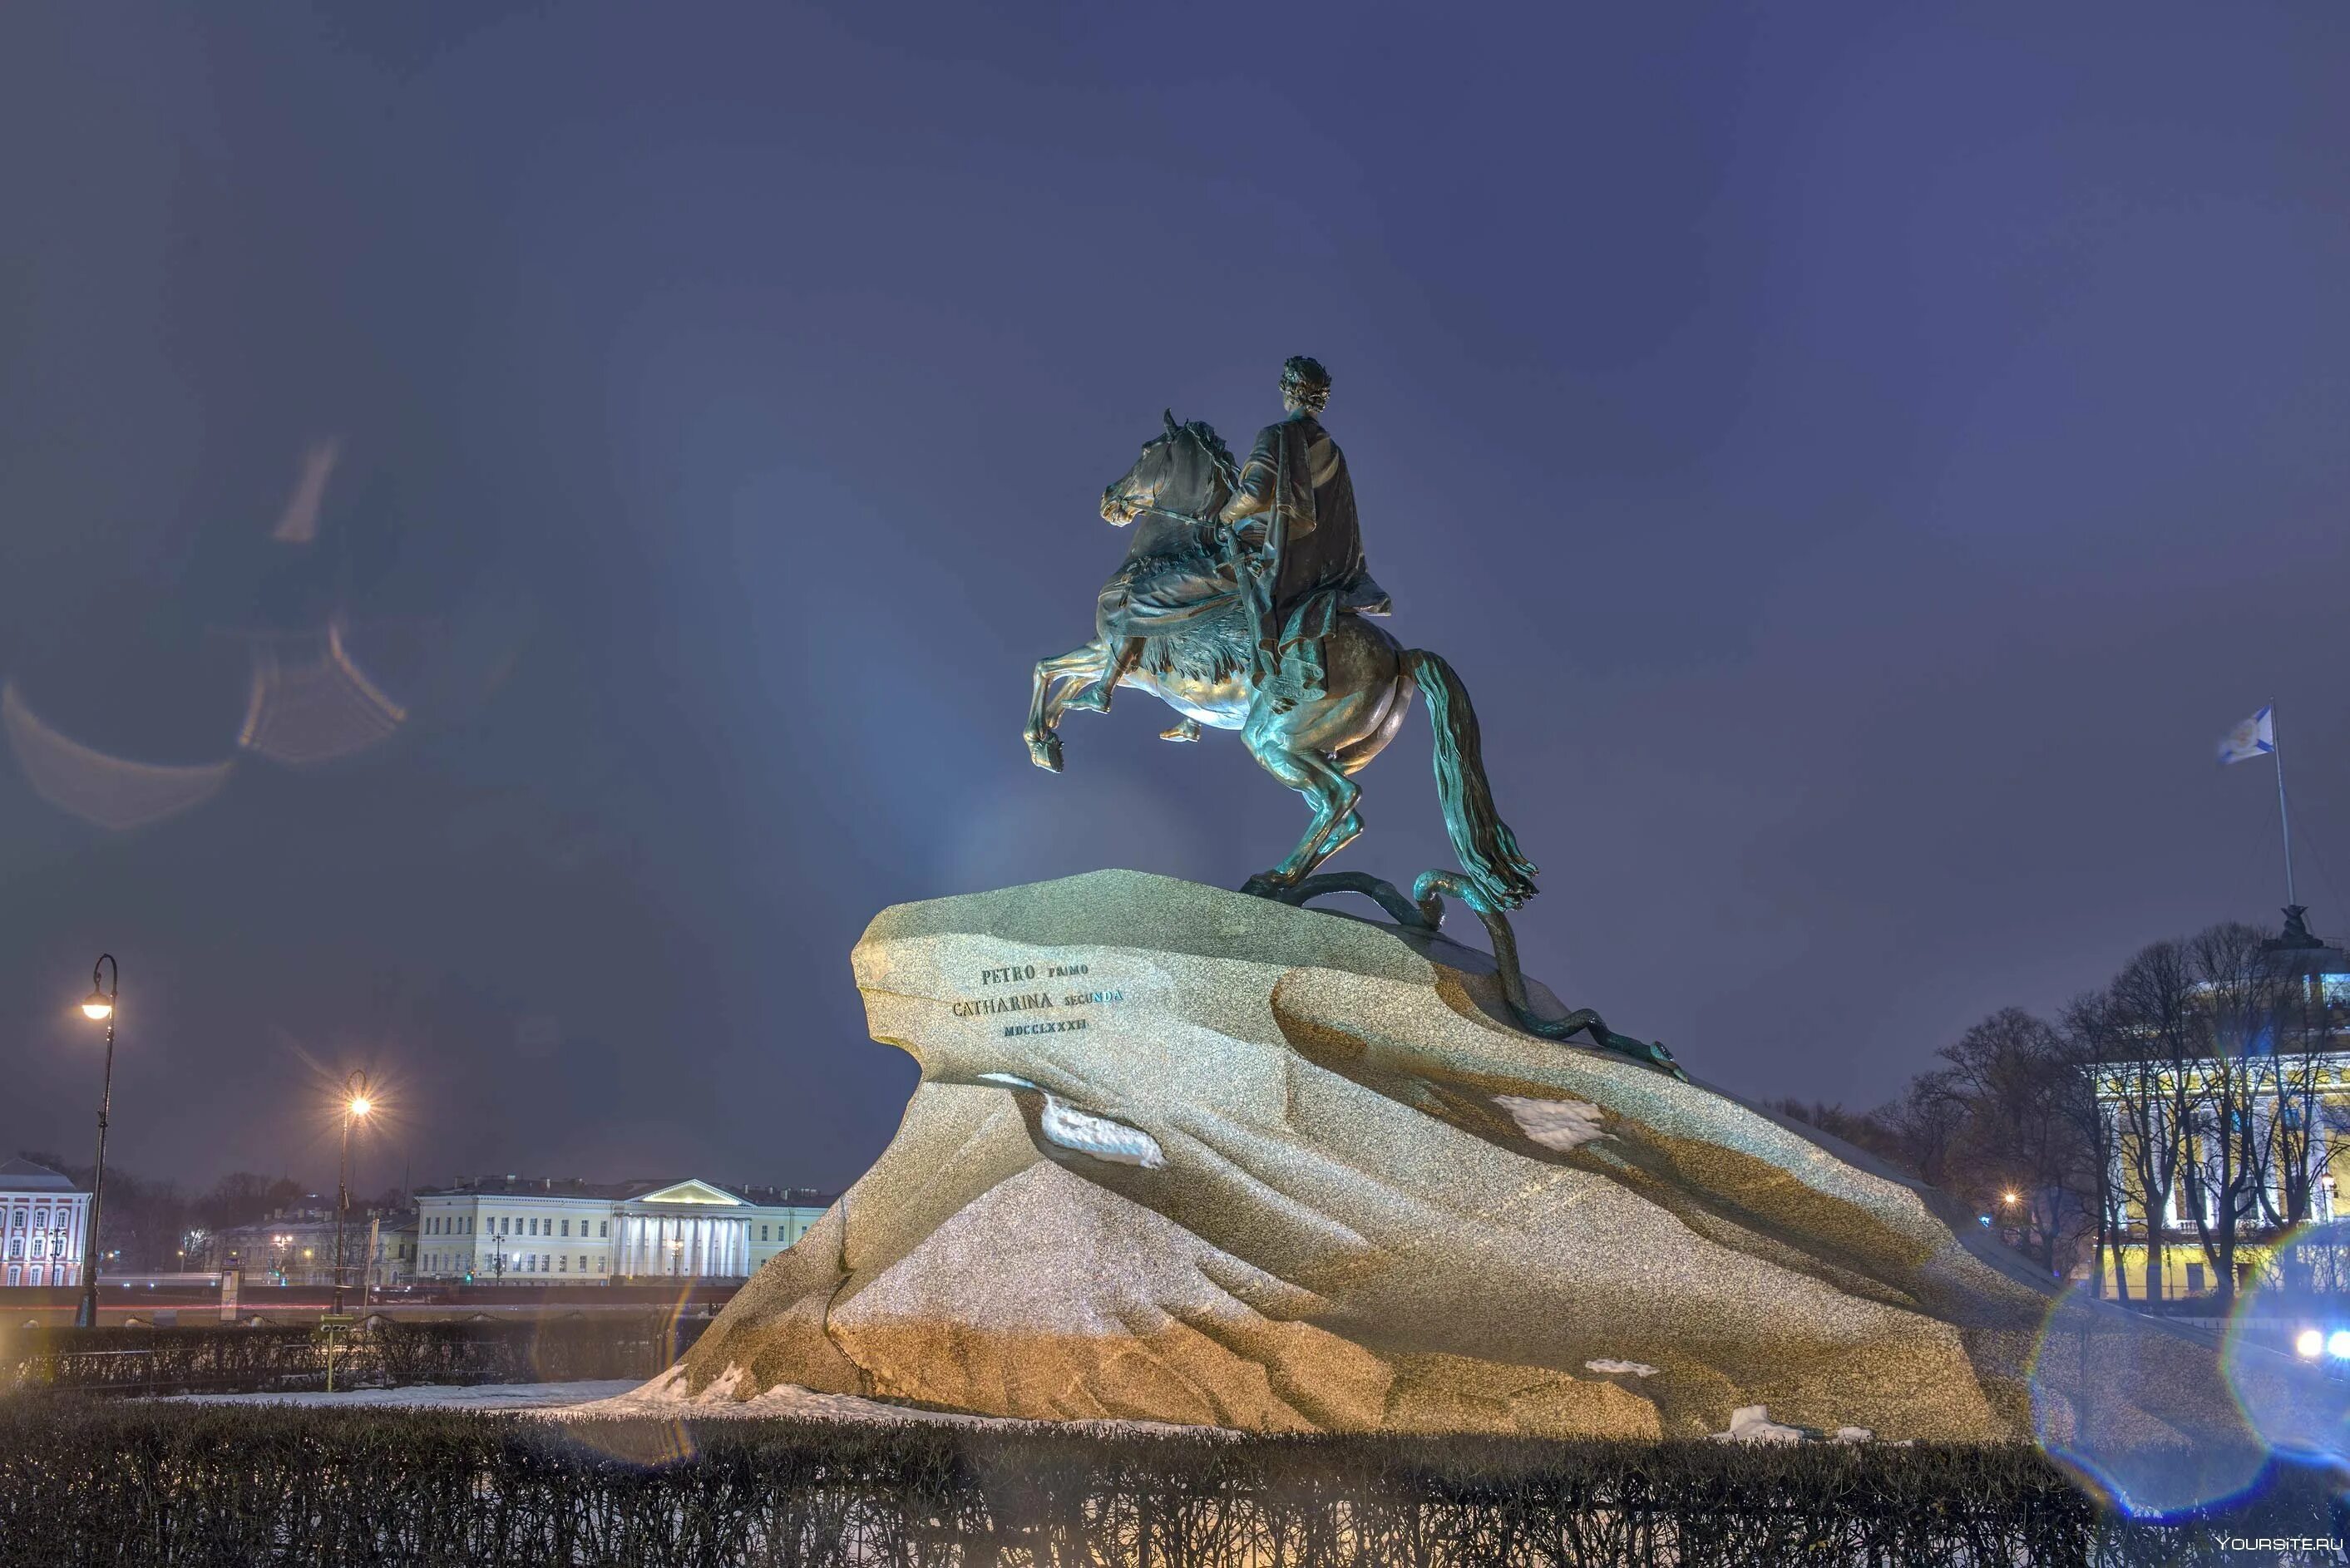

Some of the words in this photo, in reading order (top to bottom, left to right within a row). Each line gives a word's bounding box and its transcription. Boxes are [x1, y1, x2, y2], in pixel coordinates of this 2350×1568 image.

[982, 964, 1035, 985] PETRO
[1049, 964, 1089, 978] PRIMO
[953, 993, 1054, 1017] CATHARINA
[1064, 989, 1124, 1006] SECUNDA
